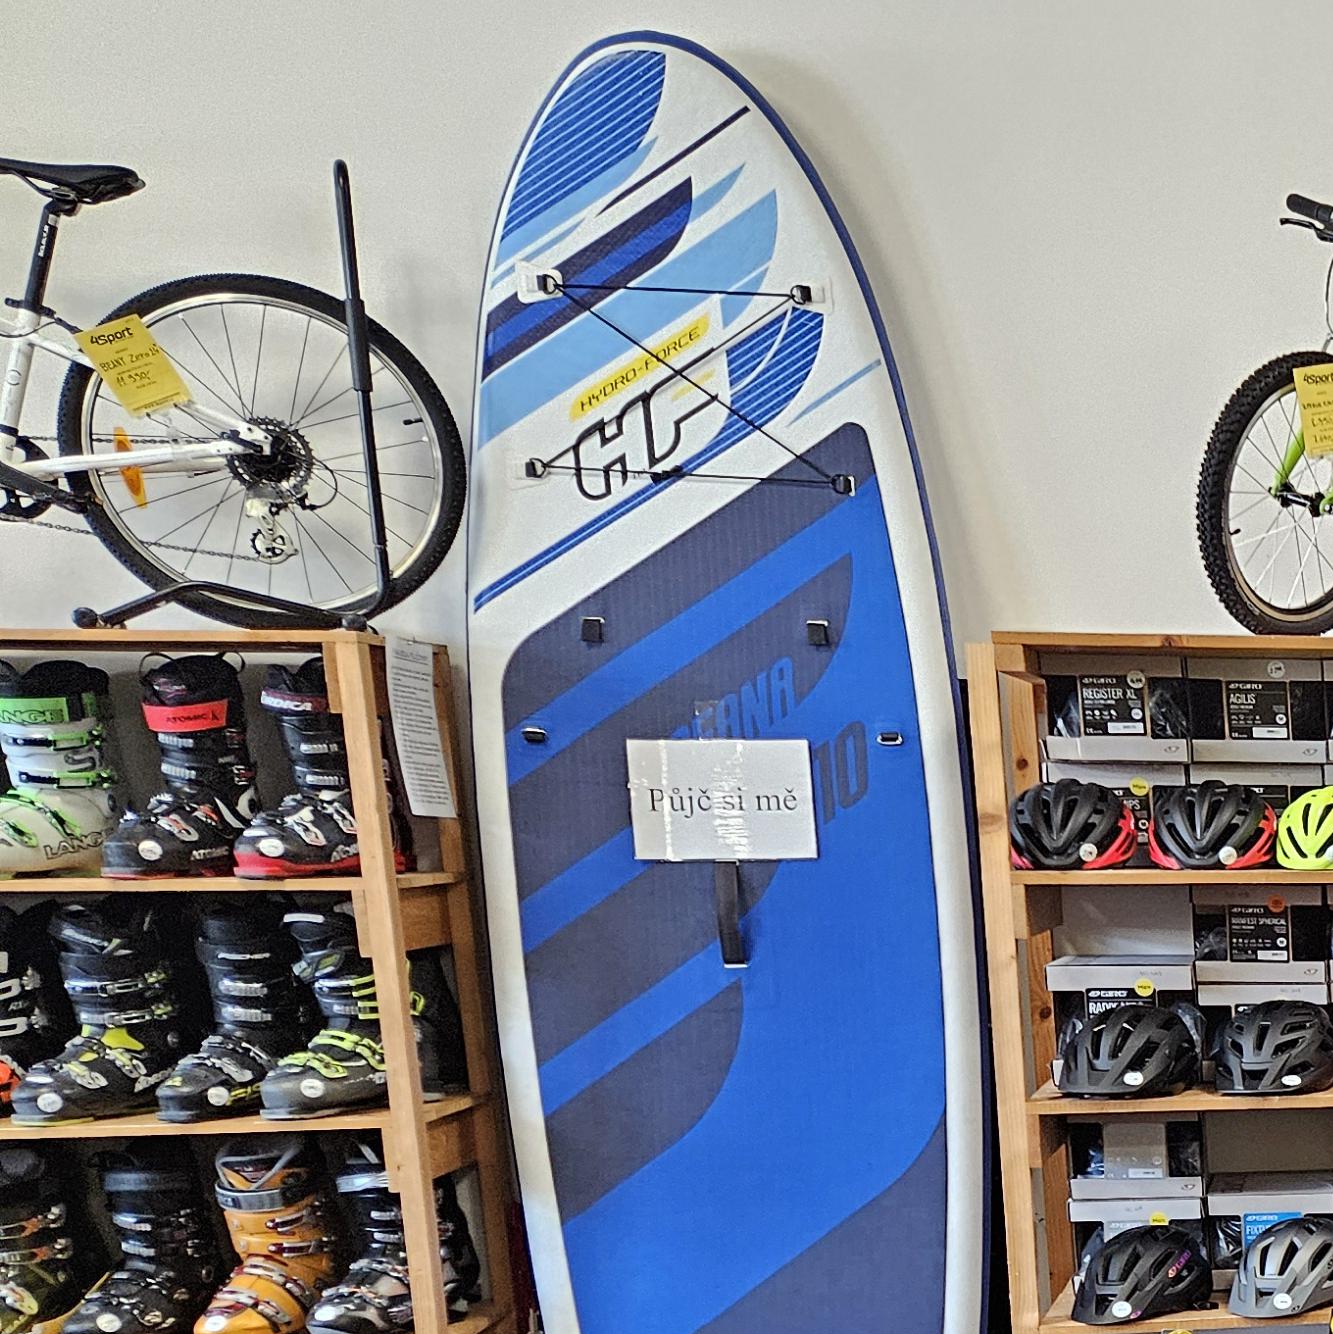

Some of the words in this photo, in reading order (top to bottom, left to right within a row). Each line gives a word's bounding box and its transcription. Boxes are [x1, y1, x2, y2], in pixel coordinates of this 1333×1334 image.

[90, 326, 133, 345] 4Sport
[580, 325, 701, 411] HYDRO-FORCE
[1082, 688, 1123, 699] REGISTER
[1125, 688, 1137, 699] XL
[1229, 693, 1256, 705] AGILIS
[0, 708, 63, 724] ANGE
[813, 720, 869, 825] 10
[648, 787, 712, 818] Půjč
[722, 788, 744, 811] si
[755, 787, 798, 811] mě
[44, 831, 104, 861] LANG
